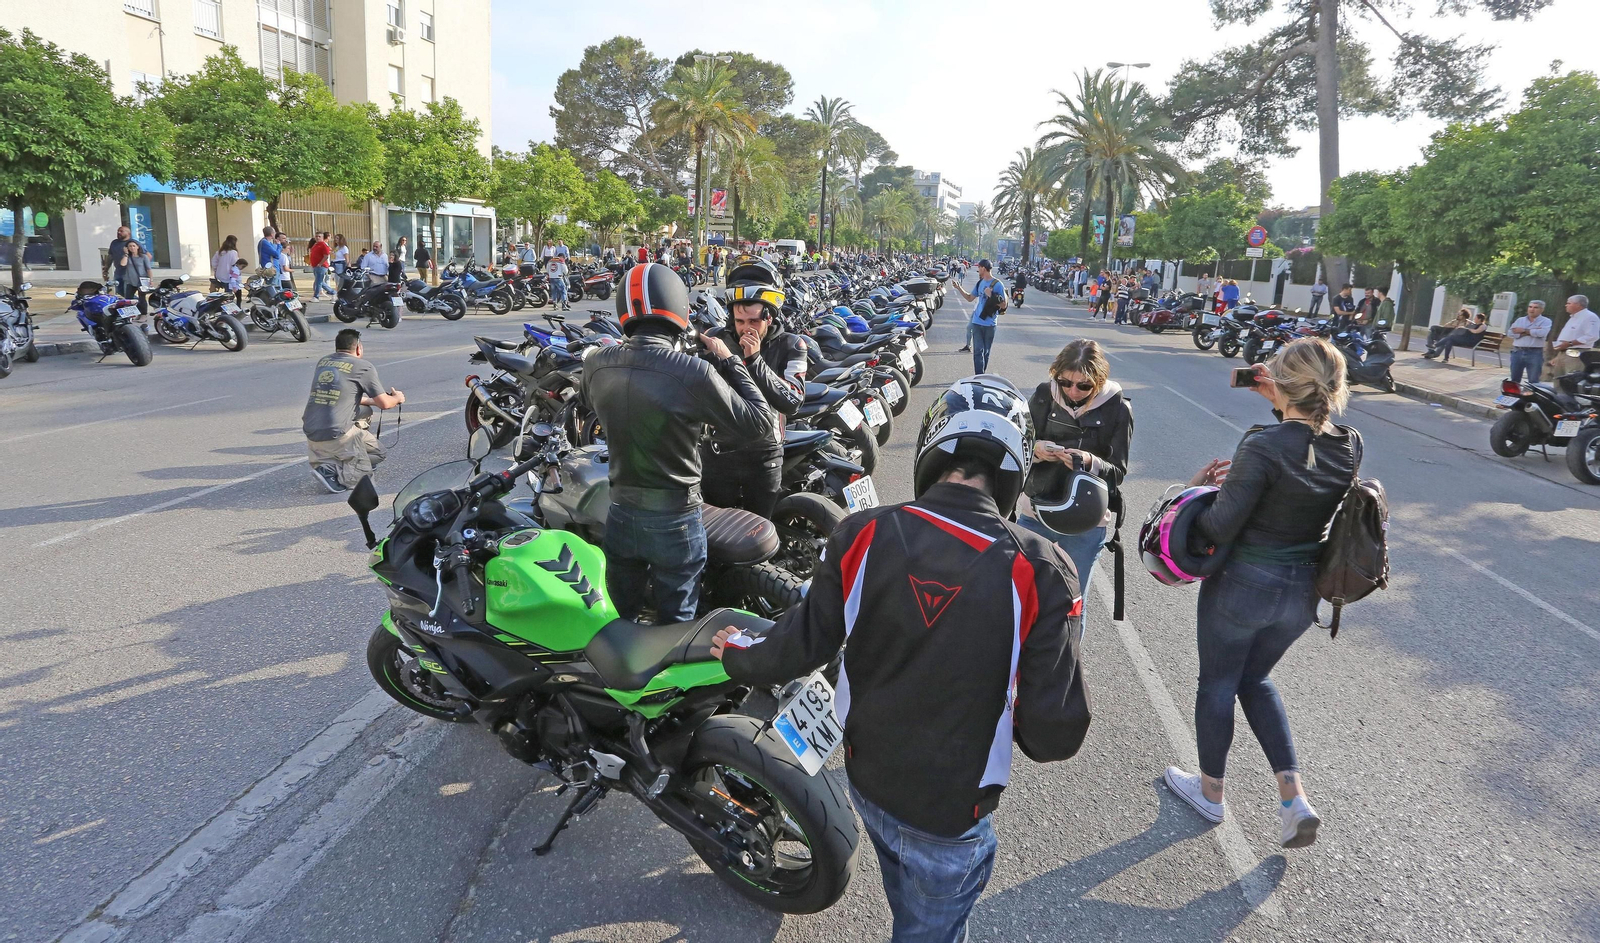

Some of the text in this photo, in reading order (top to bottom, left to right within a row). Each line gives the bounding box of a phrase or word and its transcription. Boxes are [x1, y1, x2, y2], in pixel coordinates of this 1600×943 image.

[850, 479, 871, 499] 6067
[420, 620, 446, 634] Ninja
[790, 680, 832, 732] 4193
[806, 709, 843, 759] KMT
